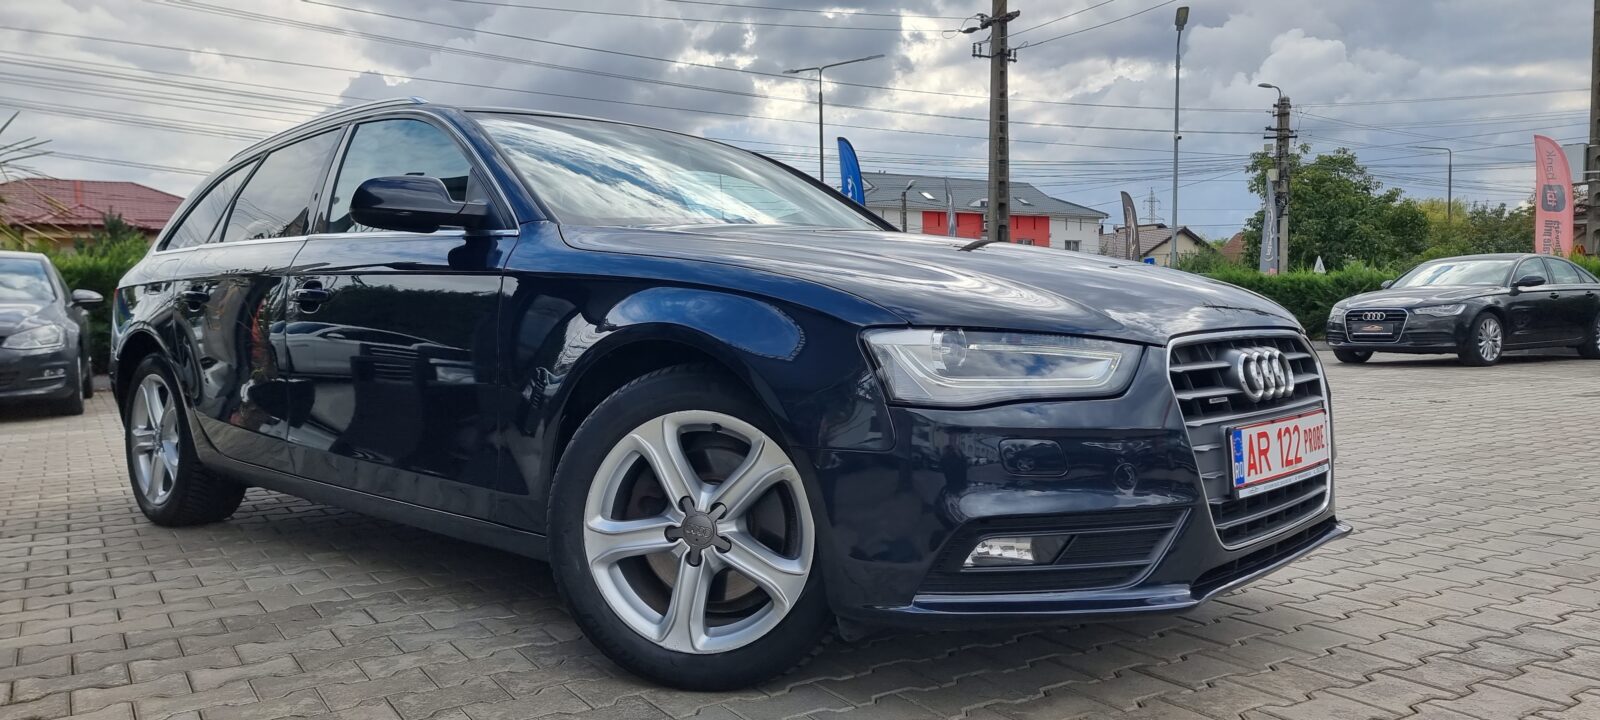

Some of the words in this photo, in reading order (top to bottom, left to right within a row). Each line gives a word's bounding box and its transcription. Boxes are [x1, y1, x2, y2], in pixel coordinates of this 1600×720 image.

[1247, 431, 1271, 477] AR
[1277, 424, 1302, 468] 122
[1304, 424, 1325, 454] PROBE
[1235, 461, 1244, 479] RO
